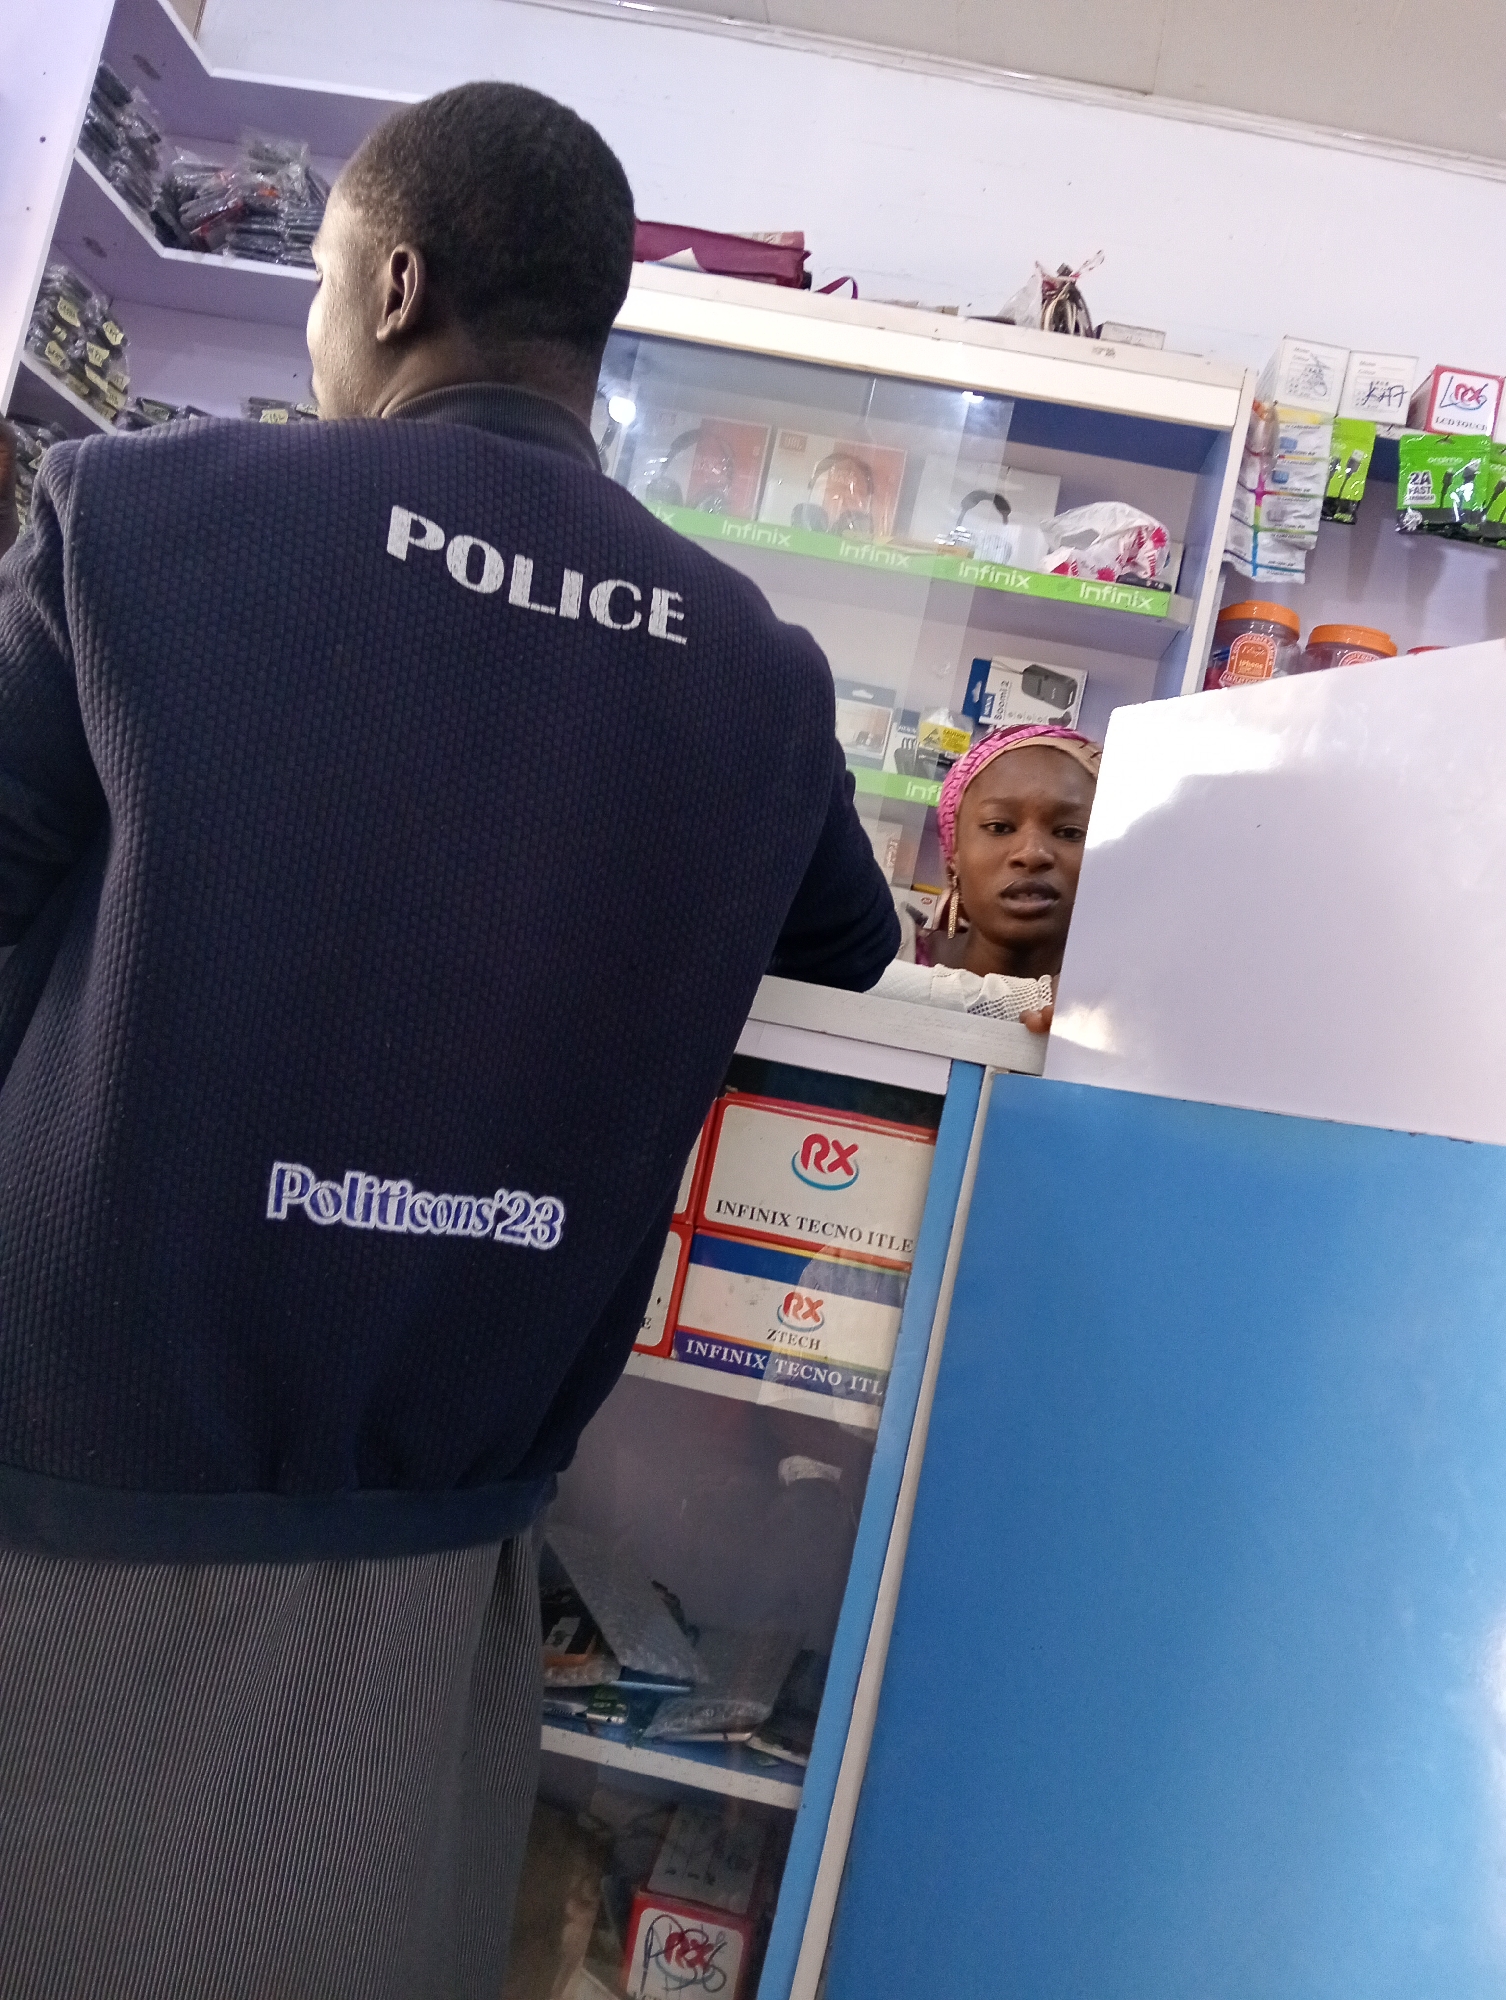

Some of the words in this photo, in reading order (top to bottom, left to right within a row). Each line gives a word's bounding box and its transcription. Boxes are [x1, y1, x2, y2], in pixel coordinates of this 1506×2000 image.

[1409, 470, 1431, 485] 2A
[721, 519, 792, 548] Infinix
[839, 540, 912, 568] Infinix
[385, 504, 688, 646] POLICE
[958, 558, 1032, 590] Infinix
[1079, 581, 1155, 611] Infinix
[801, 1133, 860, 1176] RX
[265, 1160, 566, 1251] Politicons'23
[715, 1199, 791, 1228] INFINIX
[796, 1215, 863, 1243] TECNO
[867, 1230, 914, 1254] ITLE
[783, 1290, 824, 1324] RX
[766, 1328, 821, 1351] ZTECH
[685, 1339, 769, 1370] INFINIX
[774, 1358, 843, 1387] TECNO
[850, 1375, 884, 1396] ITL
